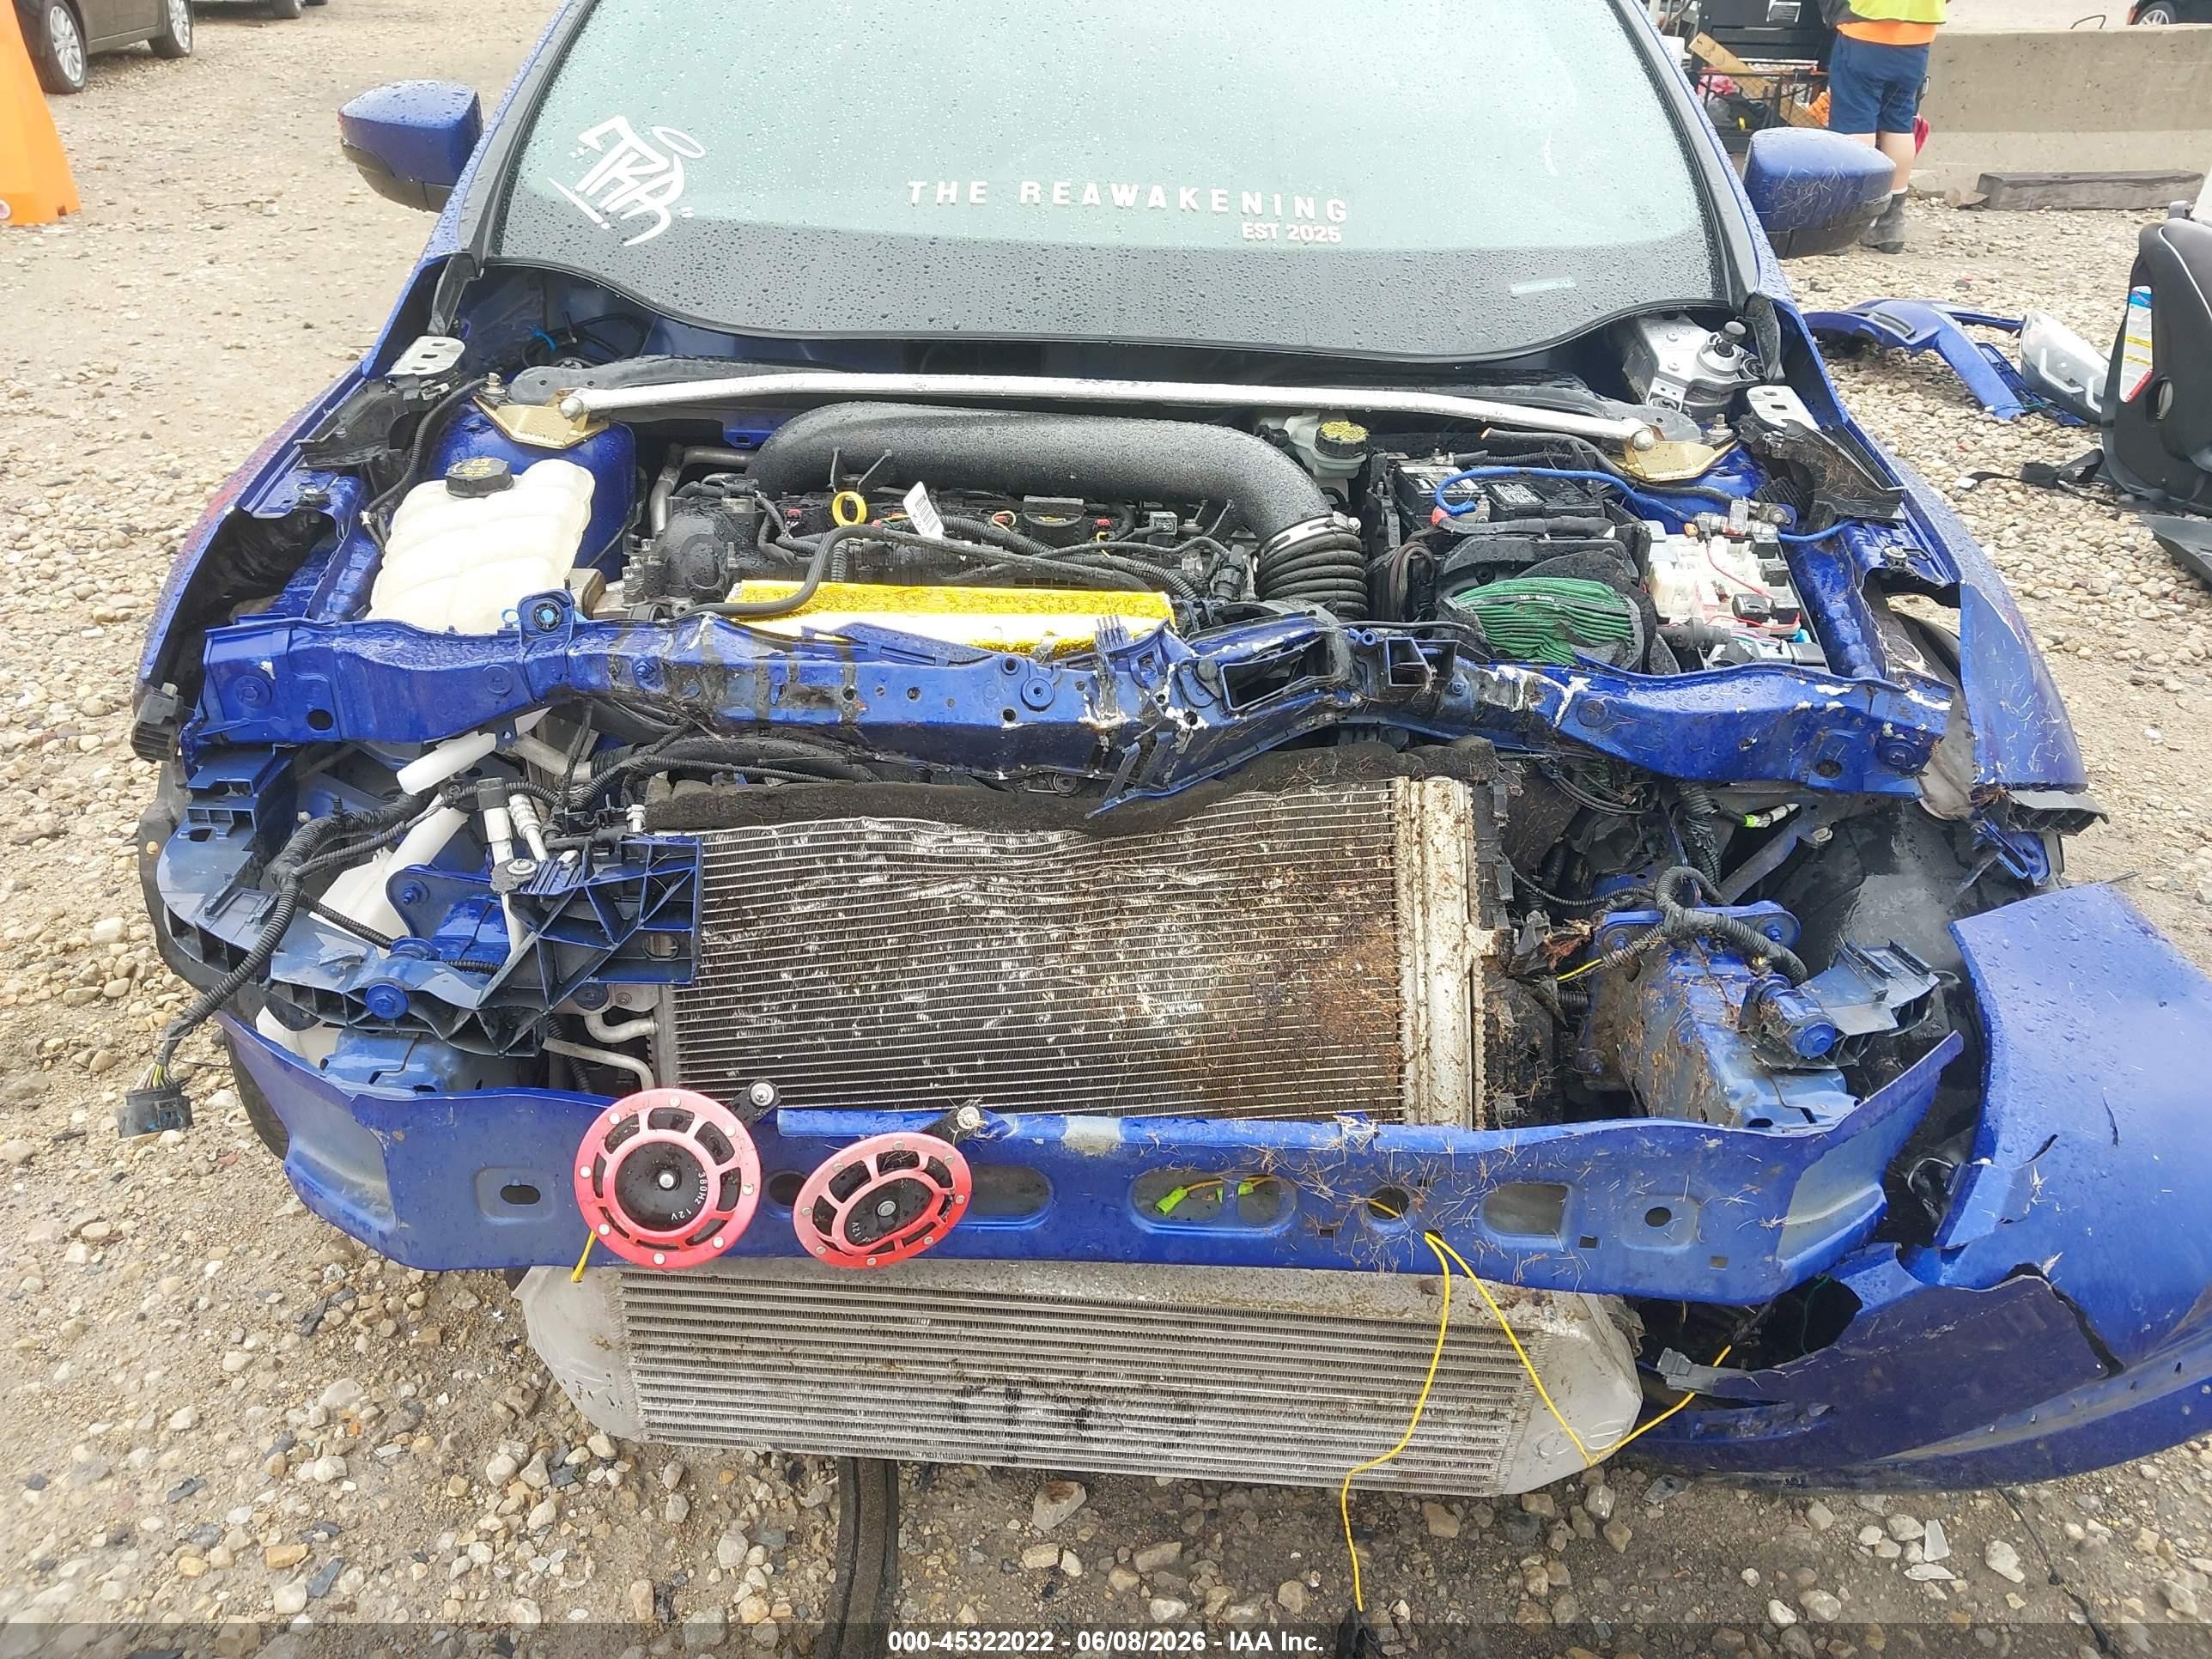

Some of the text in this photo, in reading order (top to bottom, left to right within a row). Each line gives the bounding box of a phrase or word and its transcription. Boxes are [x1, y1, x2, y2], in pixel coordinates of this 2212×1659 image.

[907, 180, 1347, 224] THE REAWAKENING
[1242, 222, 1343, 243] EST 2025
[671, 1208, 692, 1221] 12V
